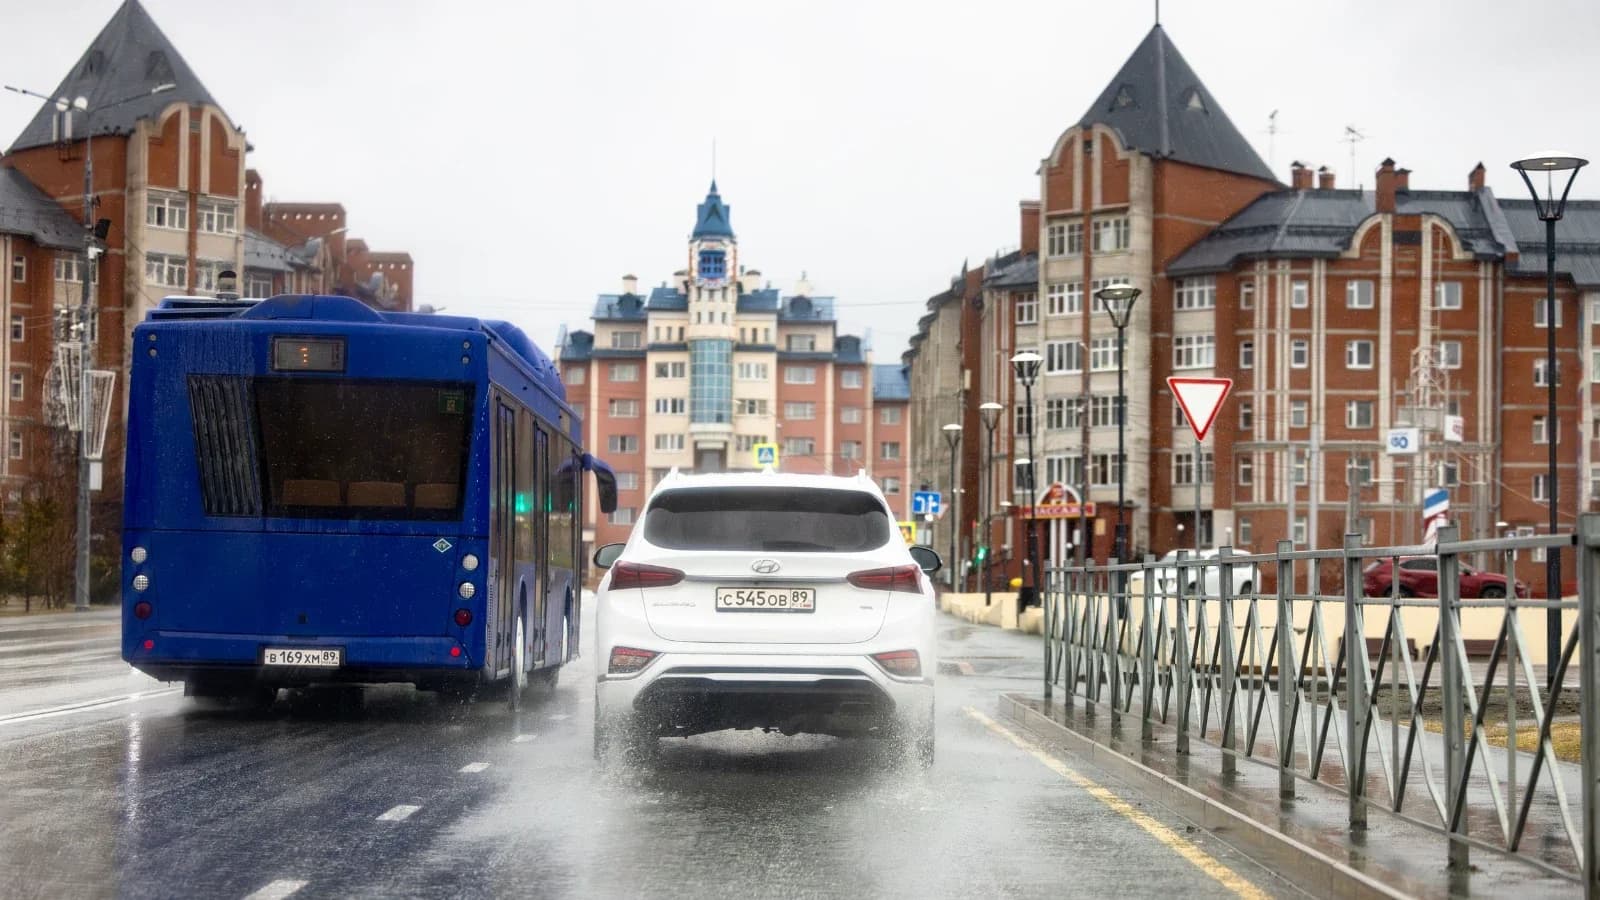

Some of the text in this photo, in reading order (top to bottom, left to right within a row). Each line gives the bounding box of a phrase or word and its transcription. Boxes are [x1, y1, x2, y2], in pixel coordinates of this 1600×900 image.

[723, 591, 788, 606] С545ОВ
[792, 591, 808, 603] 89
[269, 651, 336, 664] В169ХМ 89
